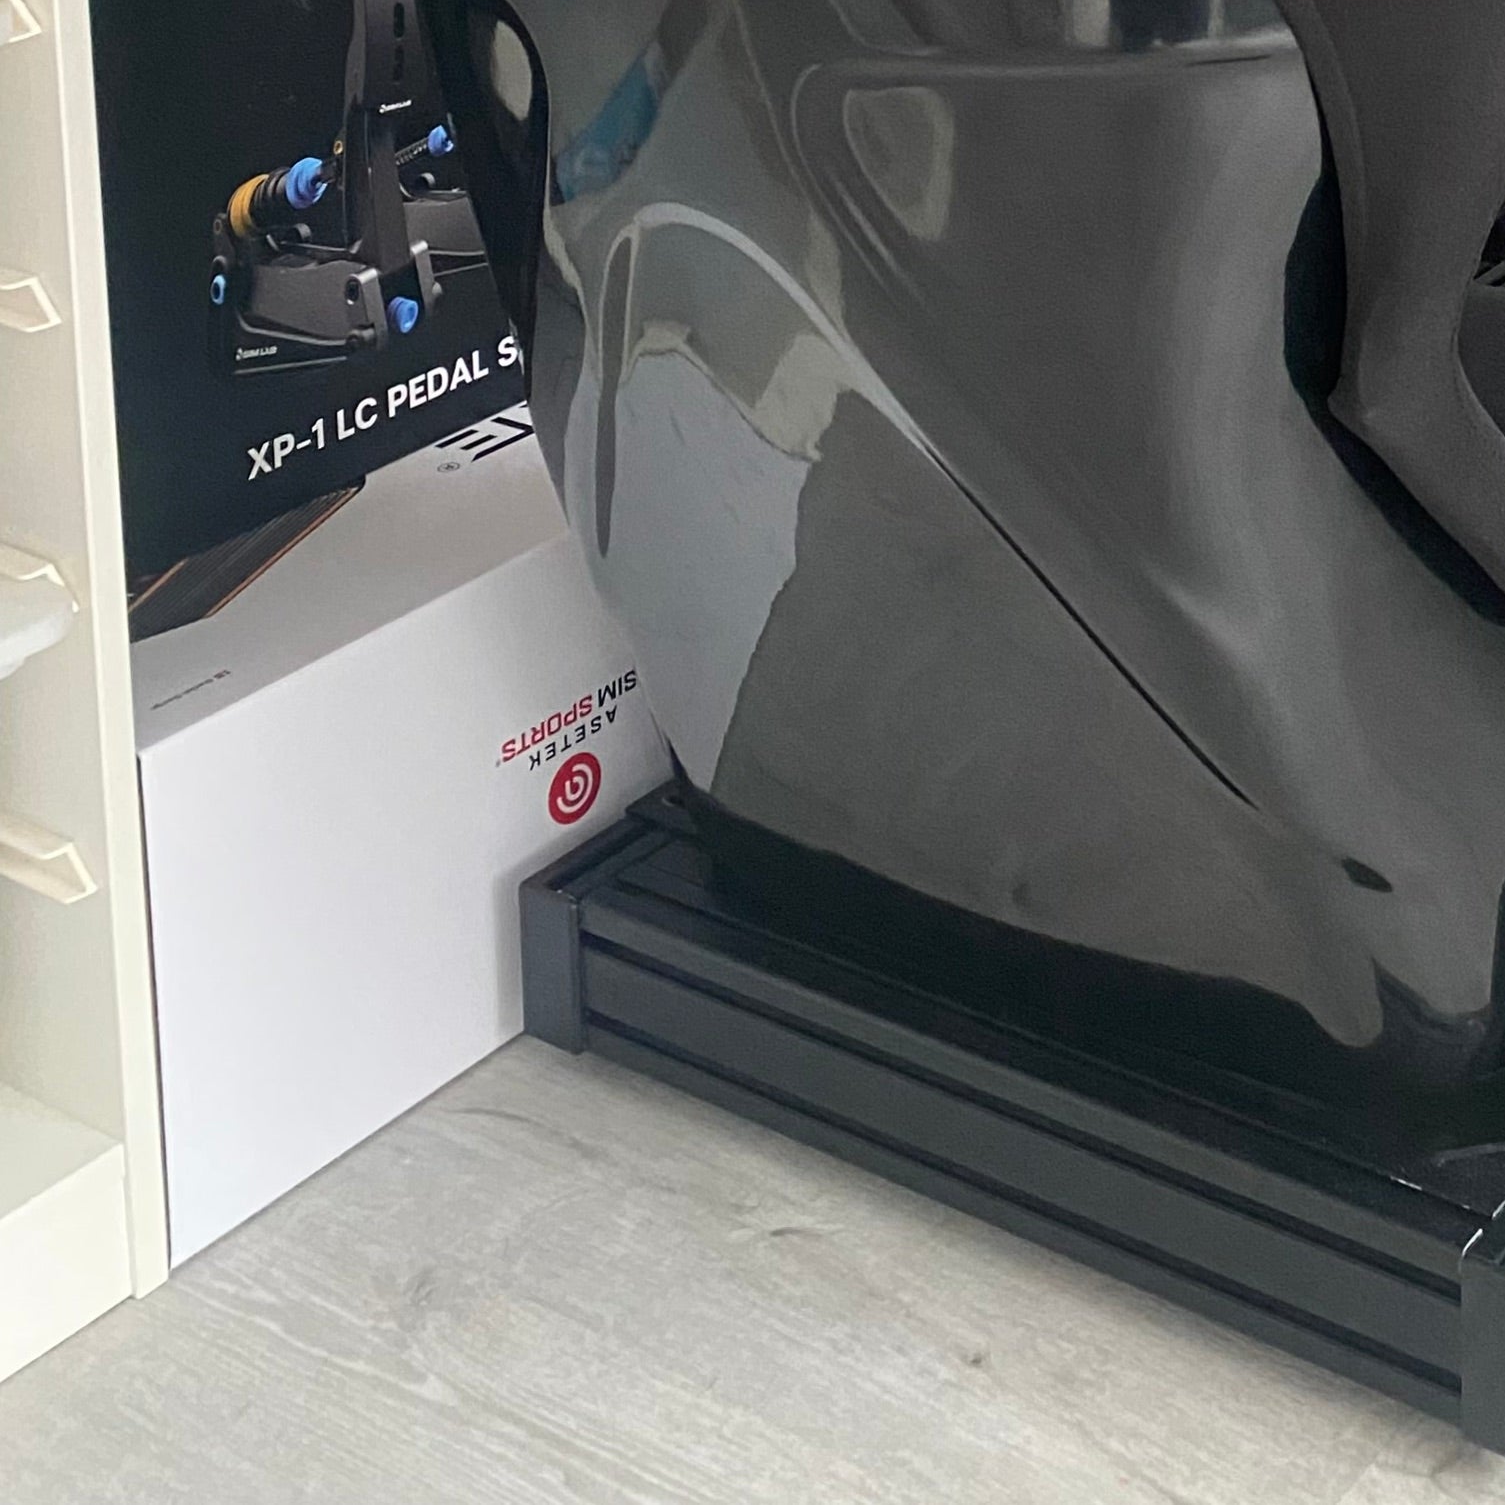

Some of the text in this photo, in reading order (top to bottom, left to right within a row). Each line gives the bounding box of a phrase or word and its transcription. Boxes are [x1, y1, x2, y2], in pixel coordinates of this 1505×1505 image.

[247, 417, 326, 481] XP-1
[336, 397, 378, 441] LC
[387, 349, 490, 418] PEDAL
[501, 669, 638, 763] SIM SPORTS
[529, 704, 618, 771] ASETEK
